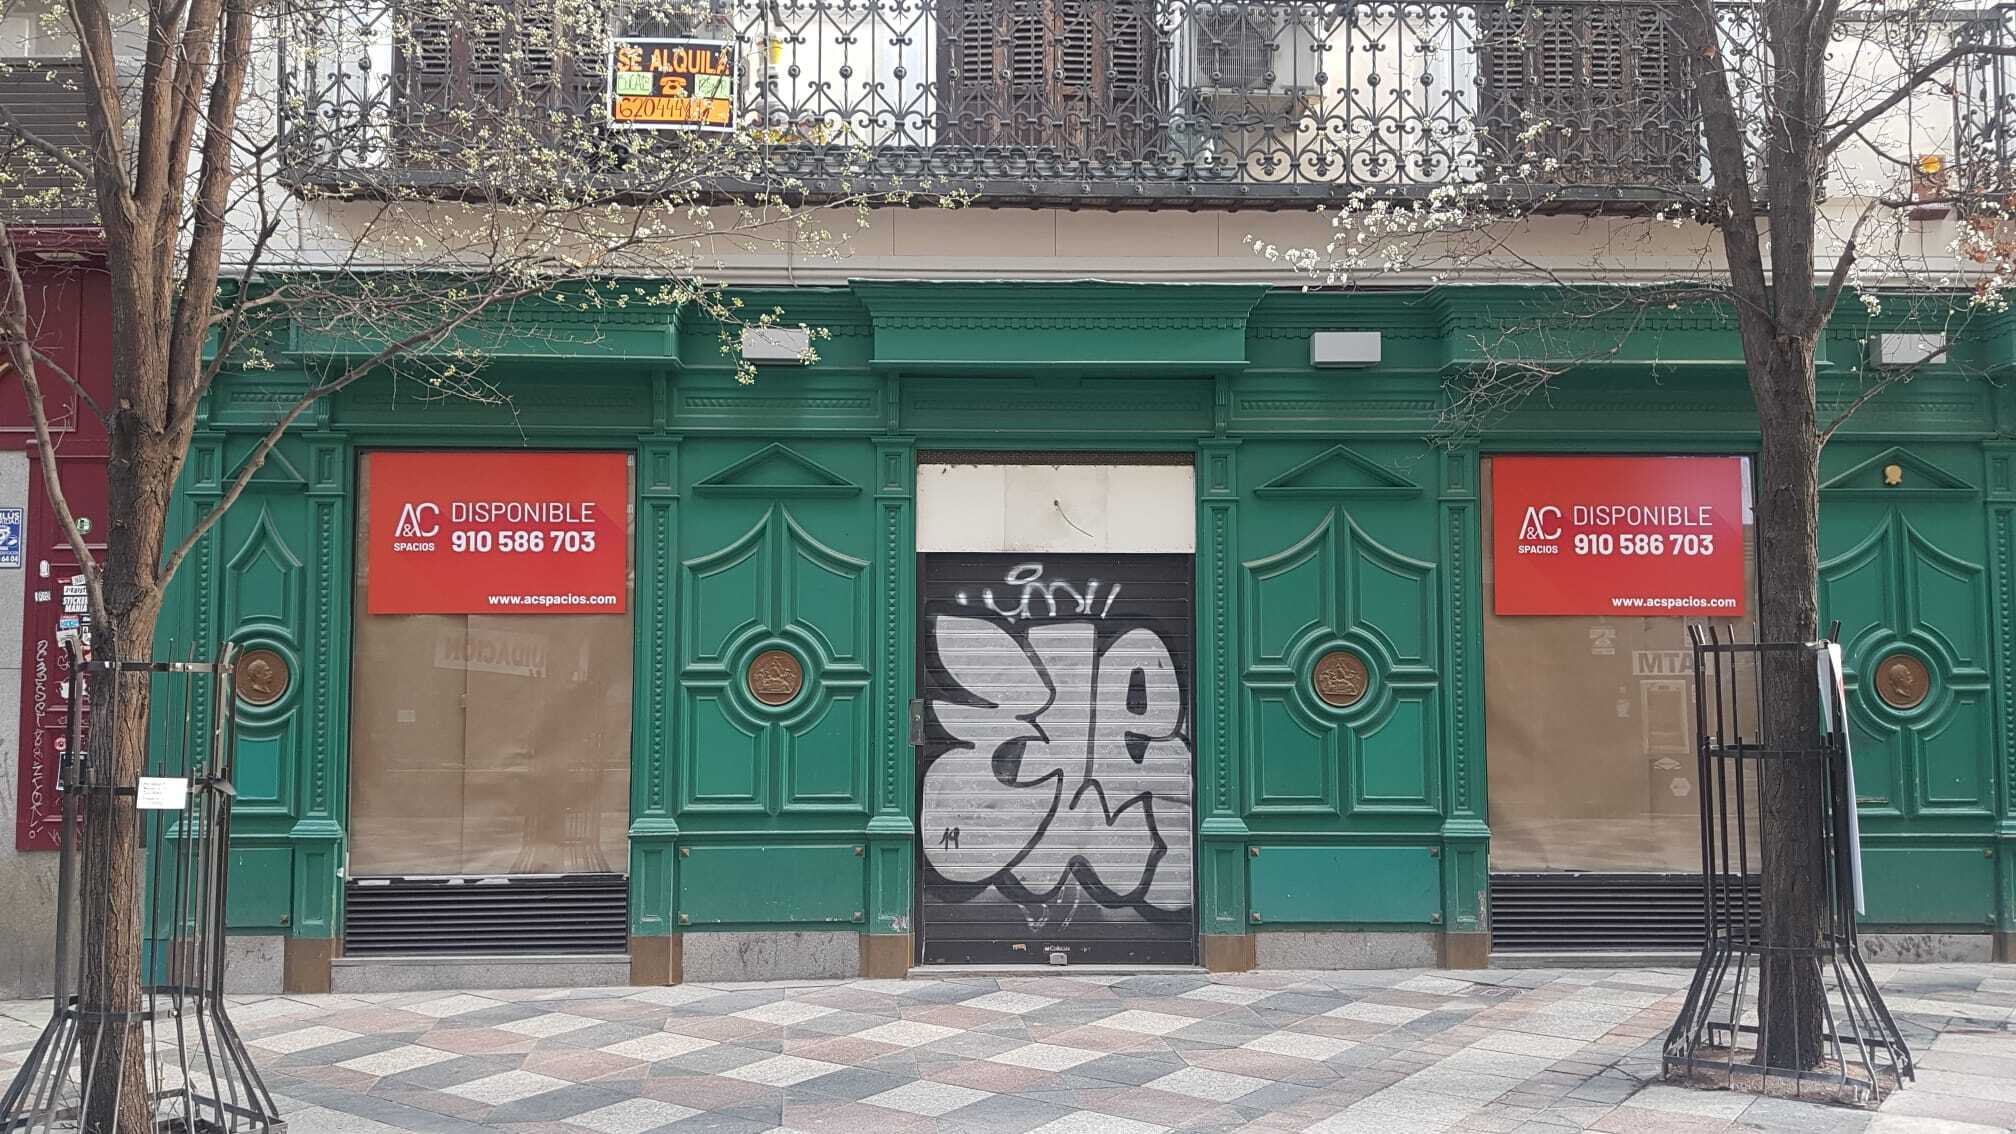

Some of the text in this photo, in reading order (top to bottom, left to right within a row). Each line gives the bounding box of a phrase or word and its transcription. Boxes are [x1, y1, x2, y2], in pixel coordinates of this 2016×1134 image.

[617, 46, 730, 75] SE ALQUILA
[451, 502, 596, 523] DISPONIBLE
[1573, 505, 1713, 526] DISPONIBLE
[393, 541, 435, 552] SPACIOS
[451, 530, 596, 553] 910 586 703
[1518, 544, 1558, 554] SPACIOS
[1574, 533, 1714, 556] 910 586 703
[488, 593, 617, 607] www.acspacios.com
[1611, 595, 1737, 609] www.acspacios.com
